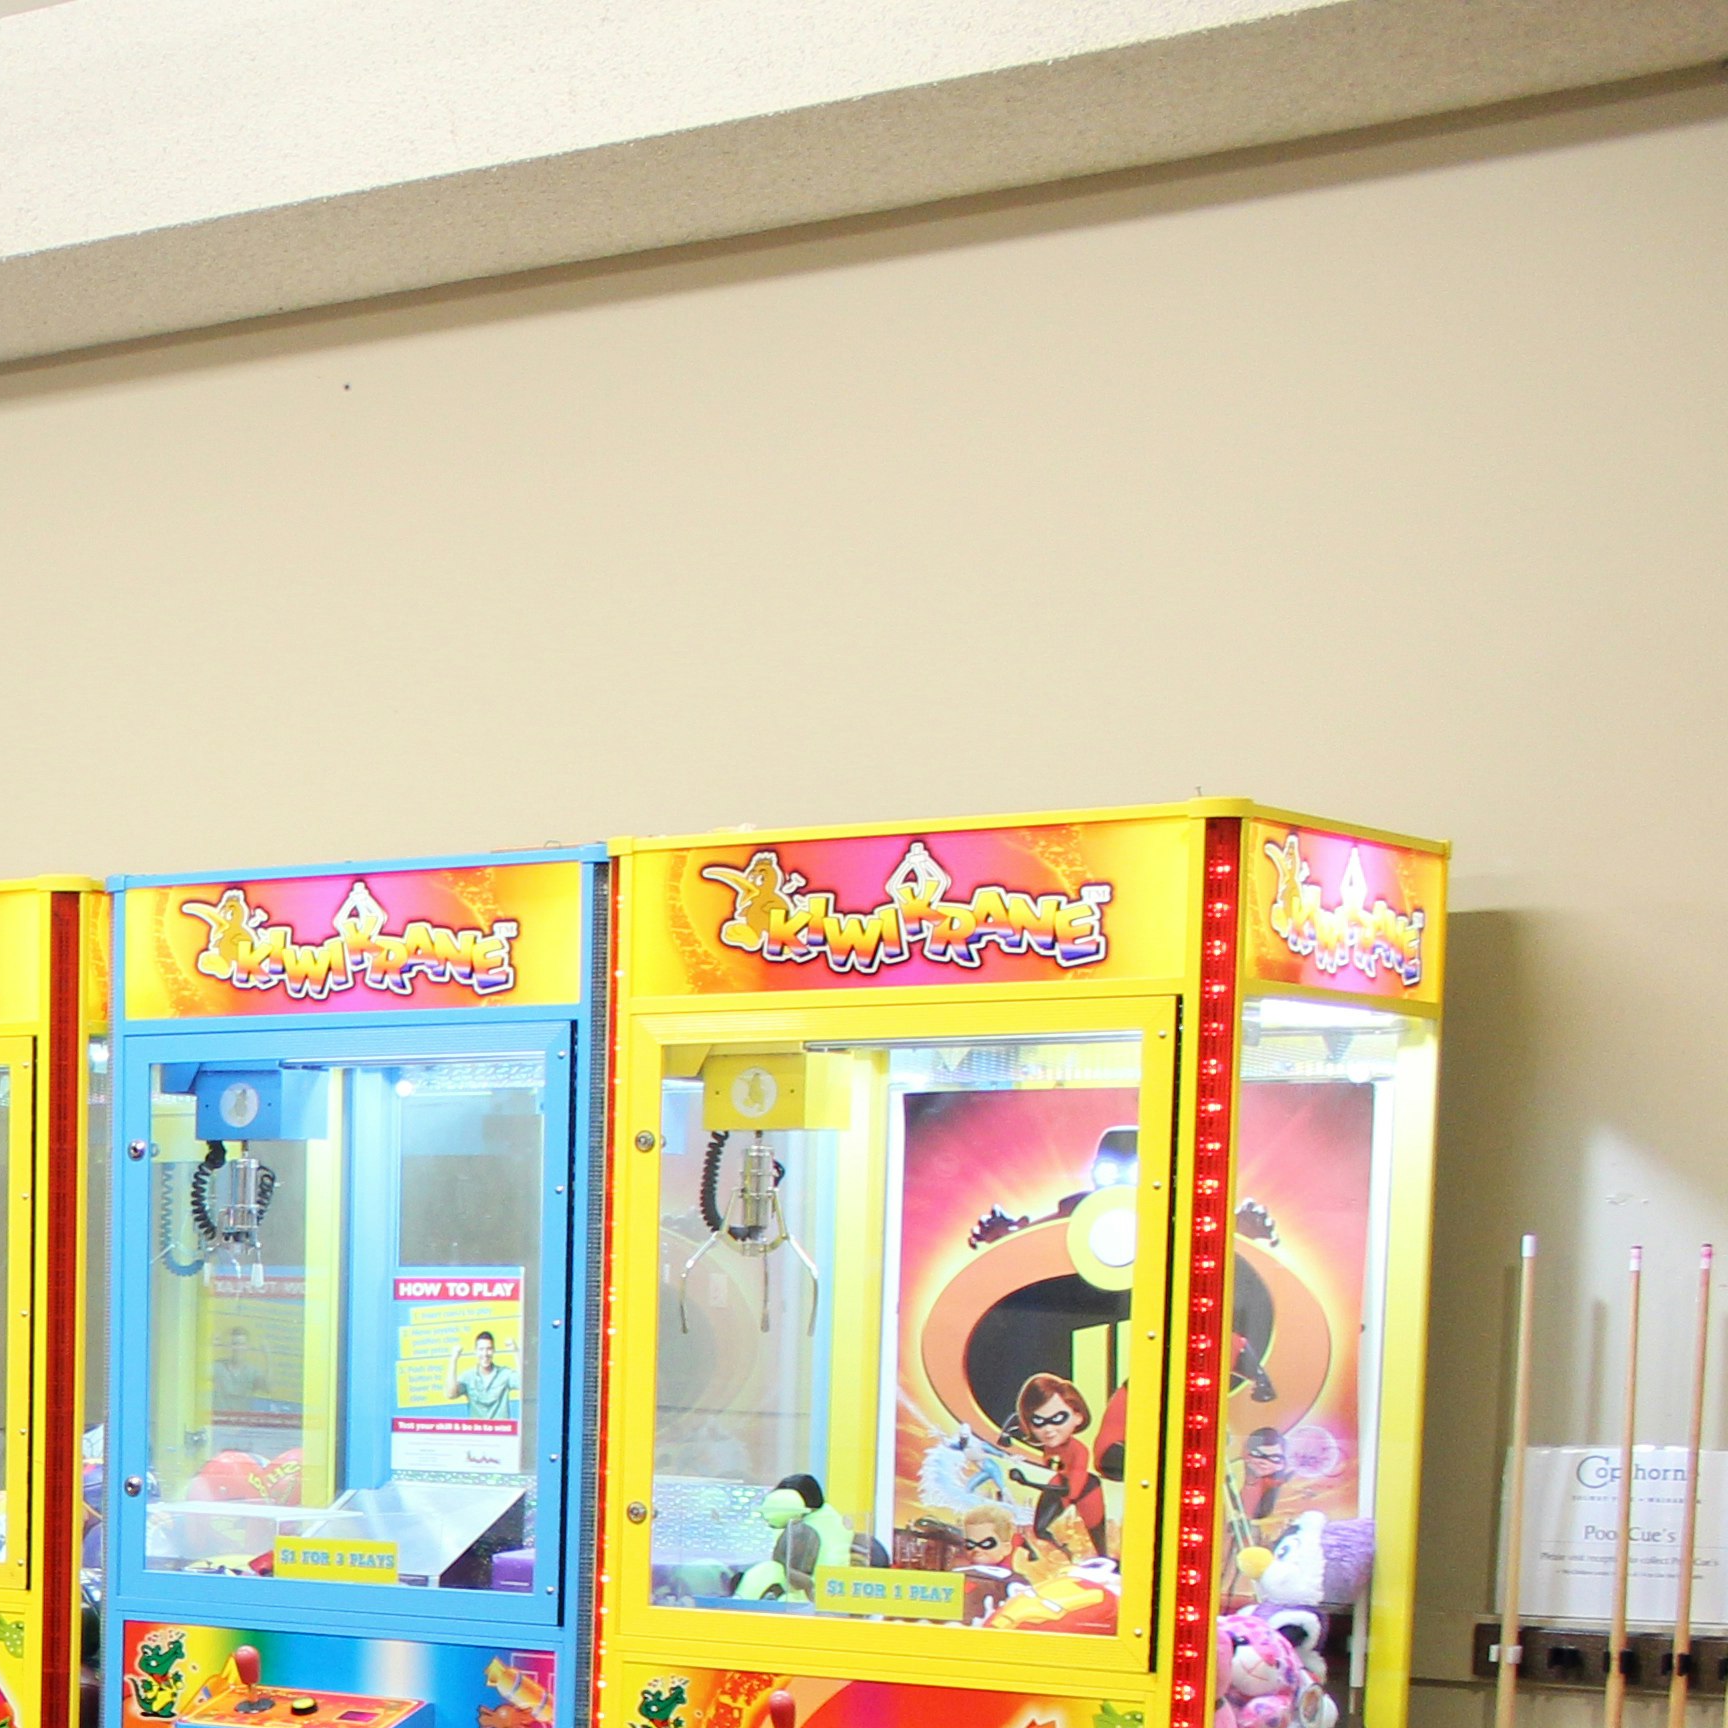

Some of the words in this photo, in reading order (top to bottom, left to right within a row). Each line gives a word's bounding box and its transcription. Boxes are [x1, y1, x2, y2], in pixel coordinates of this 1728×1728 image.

[763, 892, 909, 973] KIWI
[900, 880, 1106, 968] KRANE
[234, 926, 350, 1000] KIWI
[343, 916, 514, 996] KRANE
[399, 1282, 442, 1296] HOW
[446, 1282, 471, 1297] TO
[473, 1282, 515, 1297] PLAY
[398, 1421, 415, 1429] Test
[416, 1423, 435, 1431] your
[435, 1422, 453, 1430] skill
[462, 1423, 472, 1431] be
[483, 1424, 493, 1432] to
[1577, 1455, 1701, 1489] Cophorn
[1584, 1525, 1619, 1541] Poo
[1628, 1526, 1677, 1543] Cue's
[281, 1548, 296, 1564] $1
[302, 1550, 330, 1566] FOR
[336, 1552, 345, 1566] 3
[350, 1552, 395, 1569] PLAYS
[827, 1580, 844, 1595] $1
[853, 1581, 886, 1598] FOR
[894, 1584, 903, 1599] 1
[909, 1585, 954, 1602] PLAY
